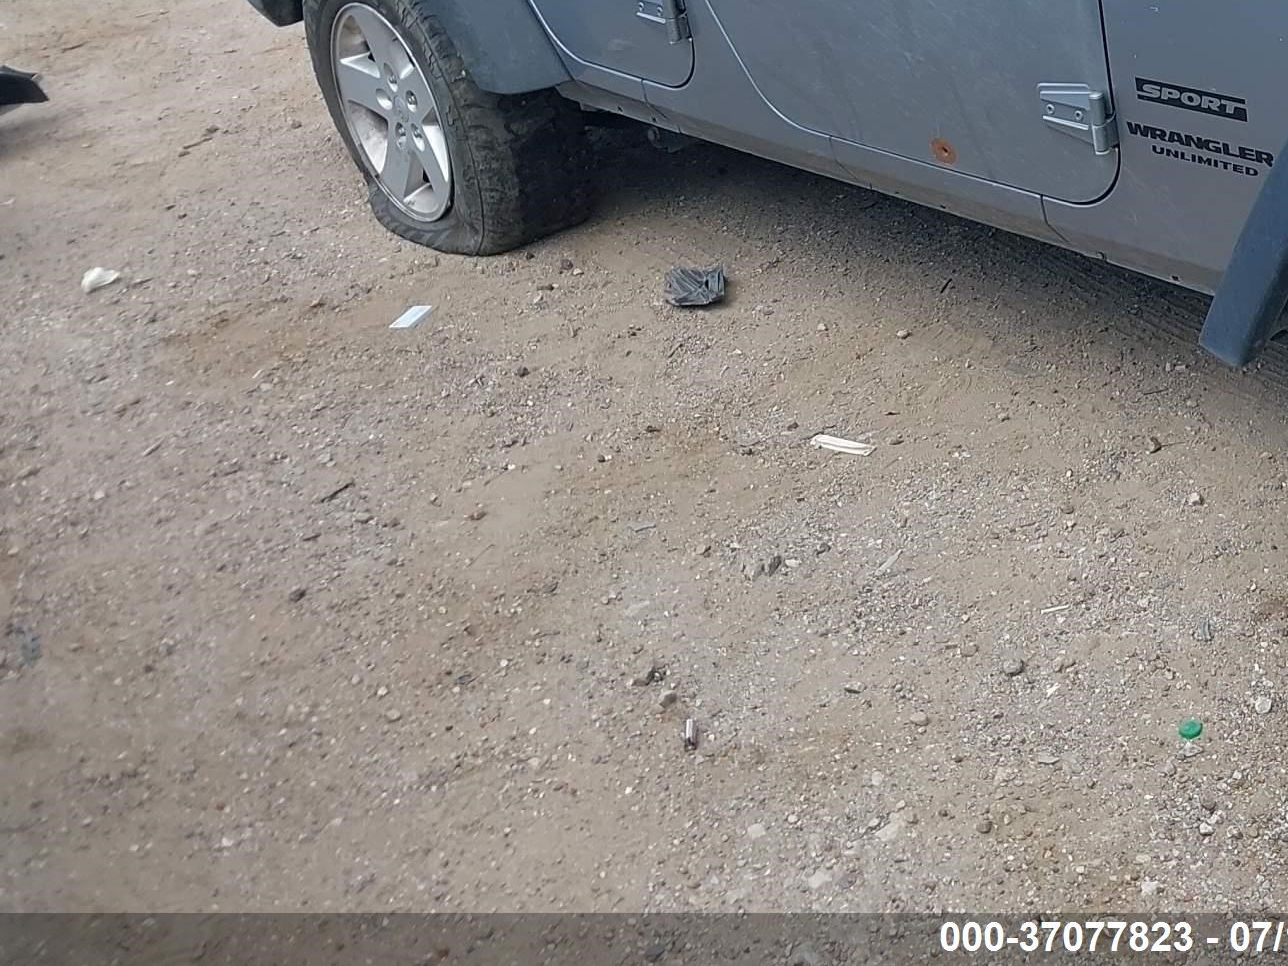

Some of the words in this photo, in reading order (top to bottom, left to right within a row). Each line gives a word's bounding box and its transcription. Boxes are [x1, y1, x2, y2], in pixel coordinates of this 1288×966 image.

[1142, 83, 1238, 115] SPORT
[1126, 121, 1274, 167] WRANGLER
[1152, 144, 1259, 177] UNLIMITED
